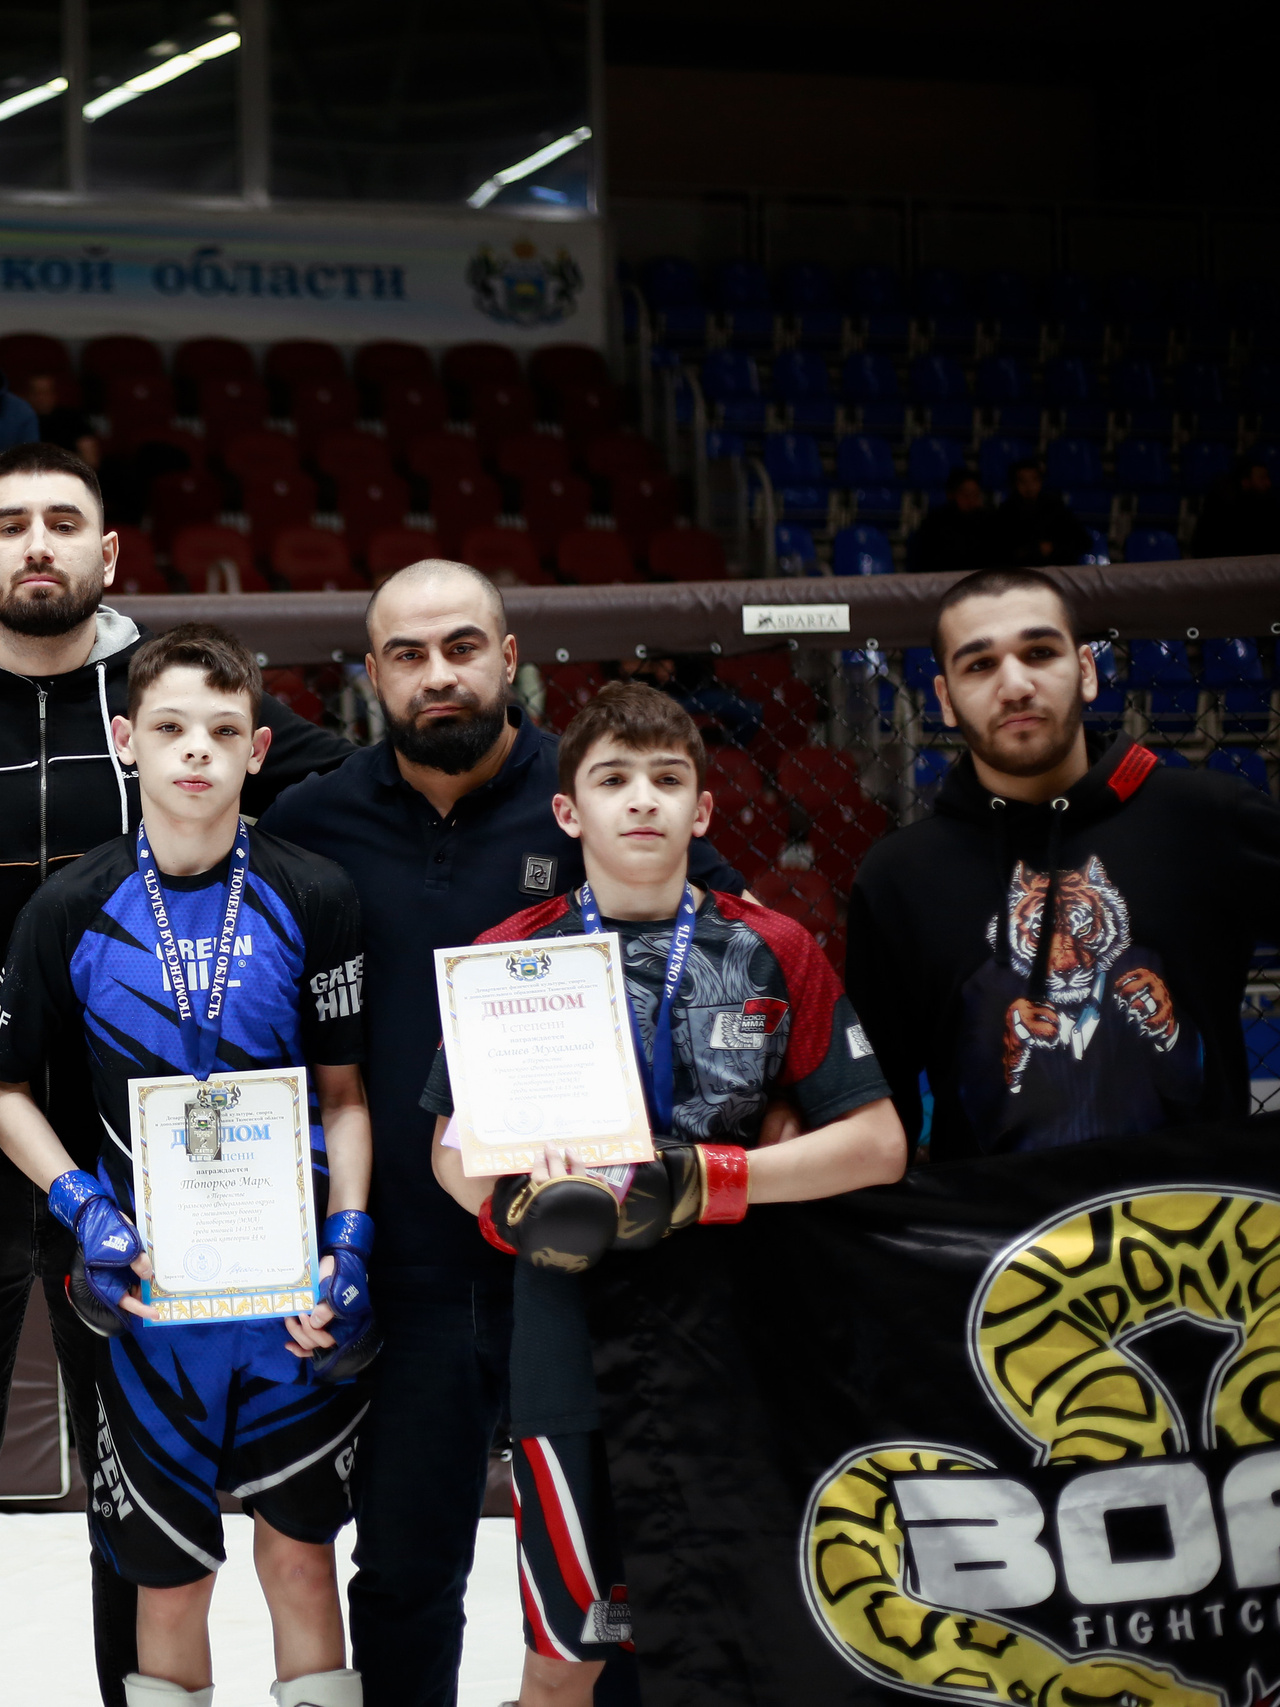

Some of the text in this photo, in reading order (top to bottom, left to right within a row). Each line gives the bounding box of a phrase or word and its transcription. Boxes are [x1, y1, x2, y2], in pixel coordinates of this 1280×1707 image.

[150, 245, 407, 300] области
[777, 613, 838, 628] SPARTA
[143, 868, 192, 1020] ТЮМЕНСКАЯ ОБЛАСТЬ
[206, 867, 245, 1021] ТЮМЕНСКАЯ ОБЛАСТЬ
[667, 924, 691, 983] ОБЛАСТЬ
[481, 992, 587, 1021] ДИПЛОМ
[509, 1021, 565, 1032] степени
[509, 1034, 565, 1044] награждается
[487, 1039, 595, 1058] Самиев Мухаммад
[170, 1124, 272, 1149] ДЛОМ
[196, 1167, 249, 1175] награждается
[180, 1176, 274, 1191] Топорков Марк
[177, 1198, 276, 1211] Уральского Федерального округа
[200, 1209, 238, 1217] смешанному
[238, 1207, 263, 1215] боевому
[195, 1218, 237, 1226] единоборству
[192, 1228, 209, 1236] среди
[210, 1226, 234, 1234] юношей
[196, 1235, 218, 1243] весовой
[1072, 1598, 1280, 1649] FIGHTC
